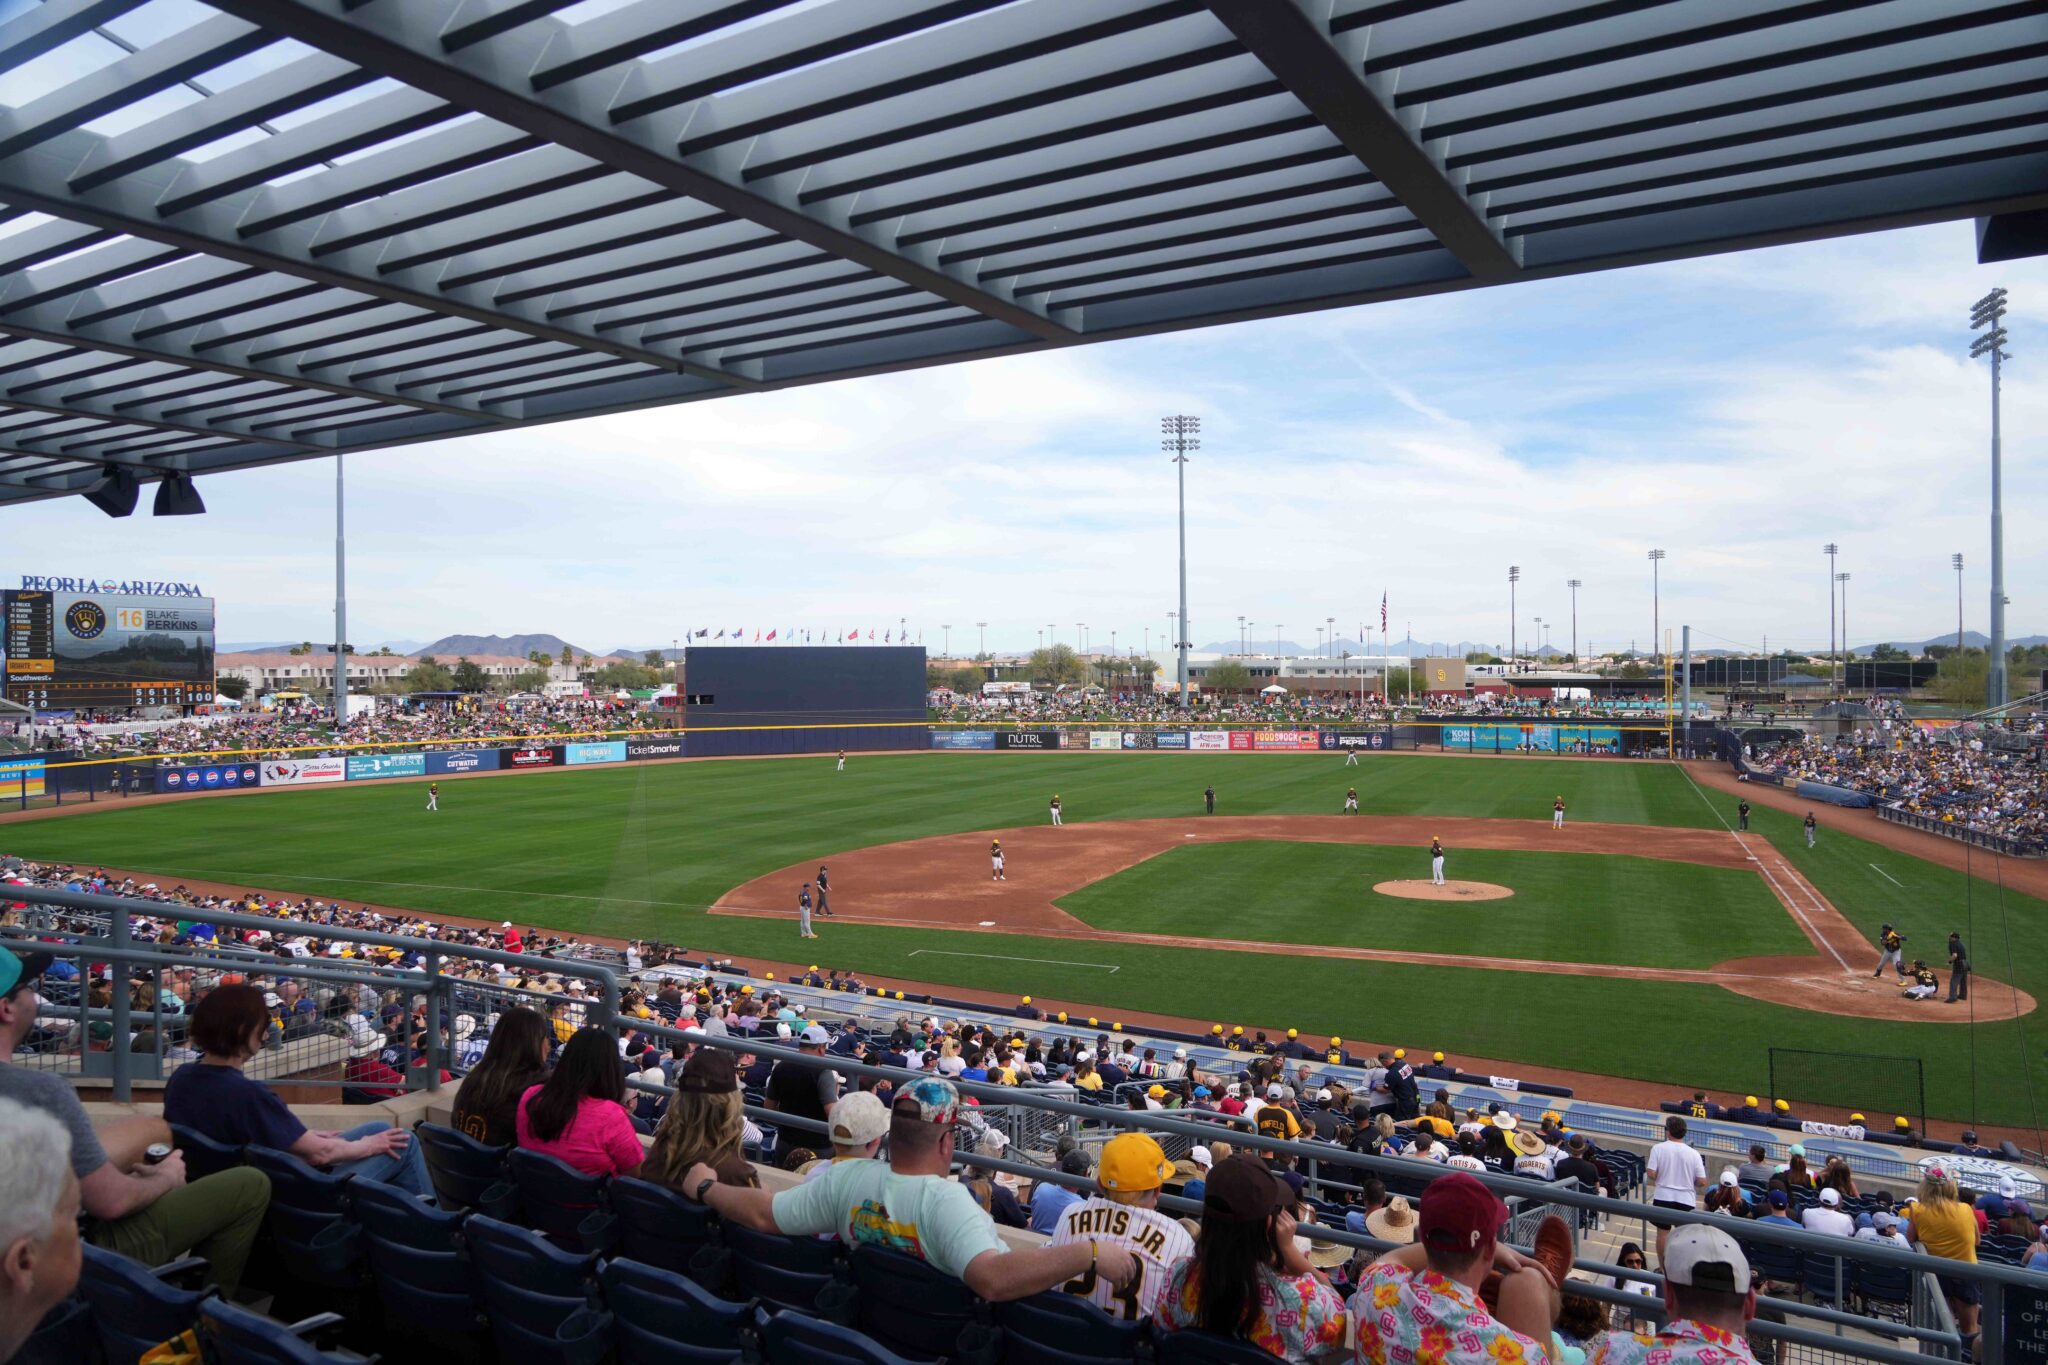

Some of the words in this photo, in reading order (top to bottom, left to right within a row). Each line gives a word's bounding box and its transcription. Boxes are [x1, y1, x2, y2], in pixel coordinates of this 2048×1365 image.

[22, 575, 100, 594] PEORIA
[117, 580, 202, 598] ARIZONA
[119, 608, 143, 627] 16
[146, 610, 180, 620] BLAKE
[147, 620, 198, 630] PERKINS
[10, 674, 48, 682] Southwest
[27, 690, 35, 698] 2
[40, 690, 47, 698] 3
[188, 693, 193, 701] 1
[196, 693, 202, 701] 0
[205, 693, 211, 701] 0
[40, 700, 47, 708] 0
[136, 697, 142, 705] 2
[149, 697, 155, 705] 3
[628, 744, 681, 755] TicketSmarter
[1691, 1107, 1706, 1118] 79
[1450, 1160, 1468, 1168] TATIS
[1068, 1208, 1129, 1236] TATIS
[1131, 1224, 1165, 1260] JR.
[1470, 1230, 1480, 1248] P
[2021, 1312, 2042, 1323] OF
[2016, 1339, 2046, 1354] THE
